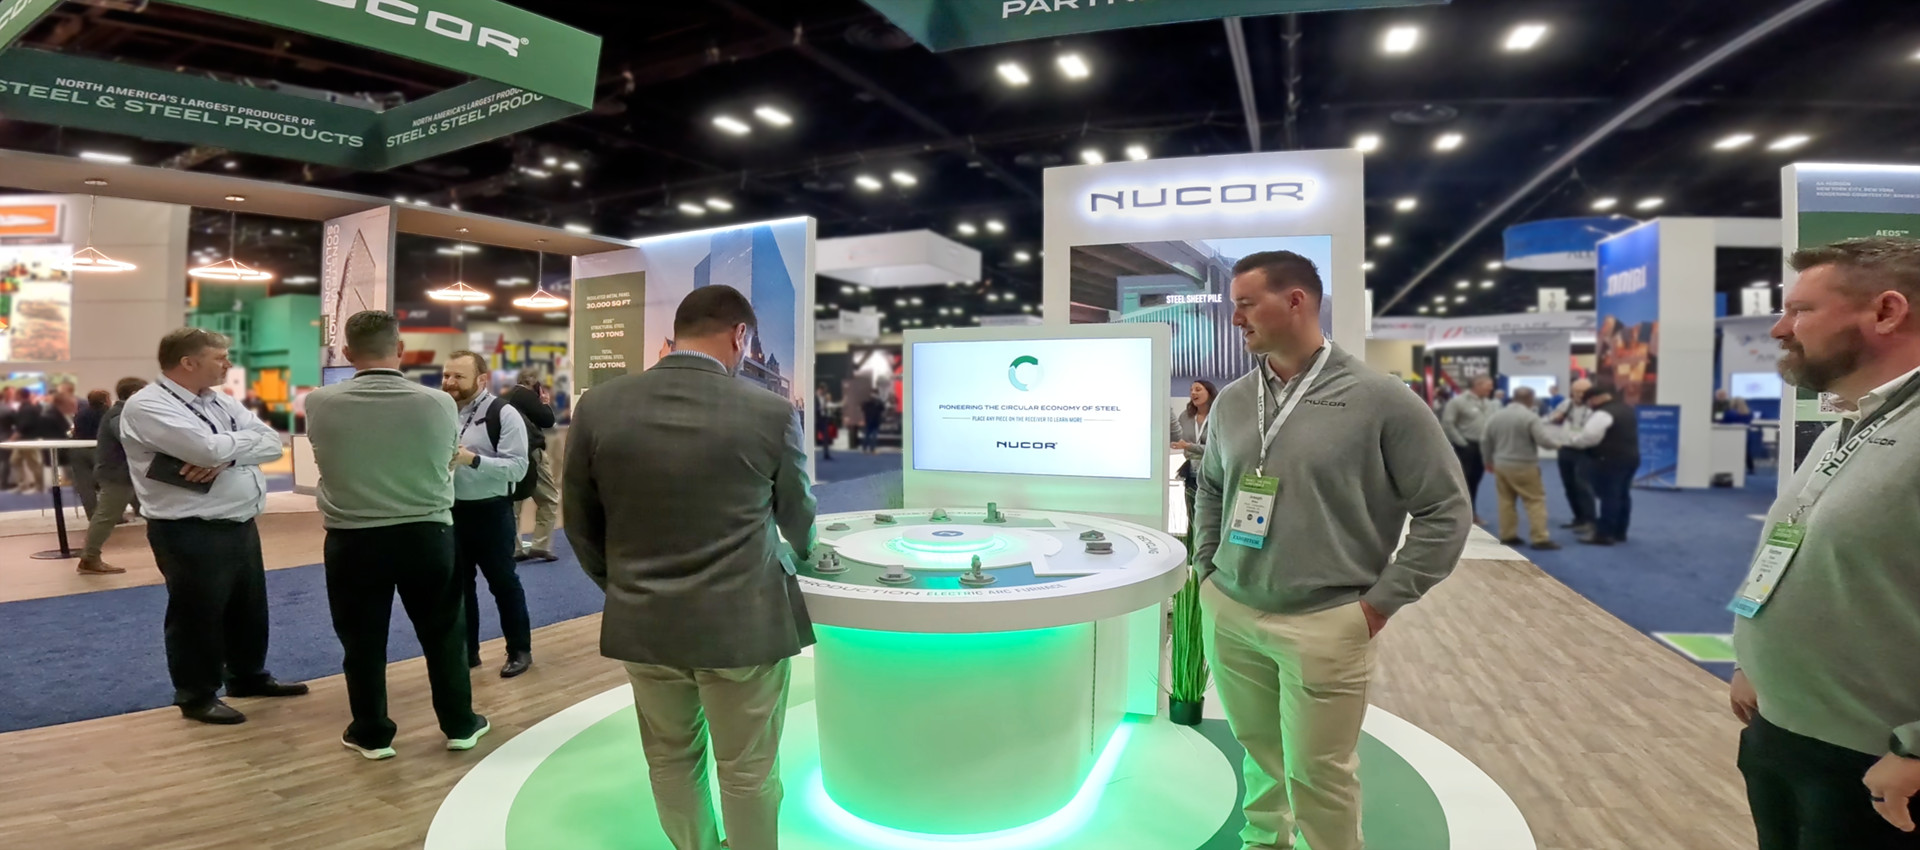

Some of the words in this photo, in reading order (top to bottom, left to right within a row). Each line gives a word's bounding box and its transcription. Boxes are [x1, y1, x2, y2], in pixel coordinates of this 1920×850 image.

[55, 77, 104, 92] NORTH
[106, 86, 178, 104] AMERICA'S
[181, 97, 236, 113] LARGEST
[238, 106, 299, 124] PRODUCER
[301, 117, 316, 127] OF
[412, 114, 433, 128] NORTH
[433, 103, 466, 124] AMERICA'S
[465, 94, 496, 112] LARGEST
[96, 95, 117, 110] &
[124, 99, 219, 125] STEEL
[225, 115, 364, 148] PRODUCTS
[386, 128, 426, 148] STEEL
[428, 123, 438, 136] &
[440, 109, 486, 132] STEEL
[1091, 181, 1305, 213] NUCOR
[586, 301, 611, 310] 30,000
[1166, 294, 1186, 304] STEEL
[1186, 294, 1207, 303] SHEET
[1207, 293, 1223, 303] PILE
[605, 330, 625, 338] TONS
[1304, 399, 1346, 408] NUCOR
[1015, 583, 1067, 594] FURNACE
